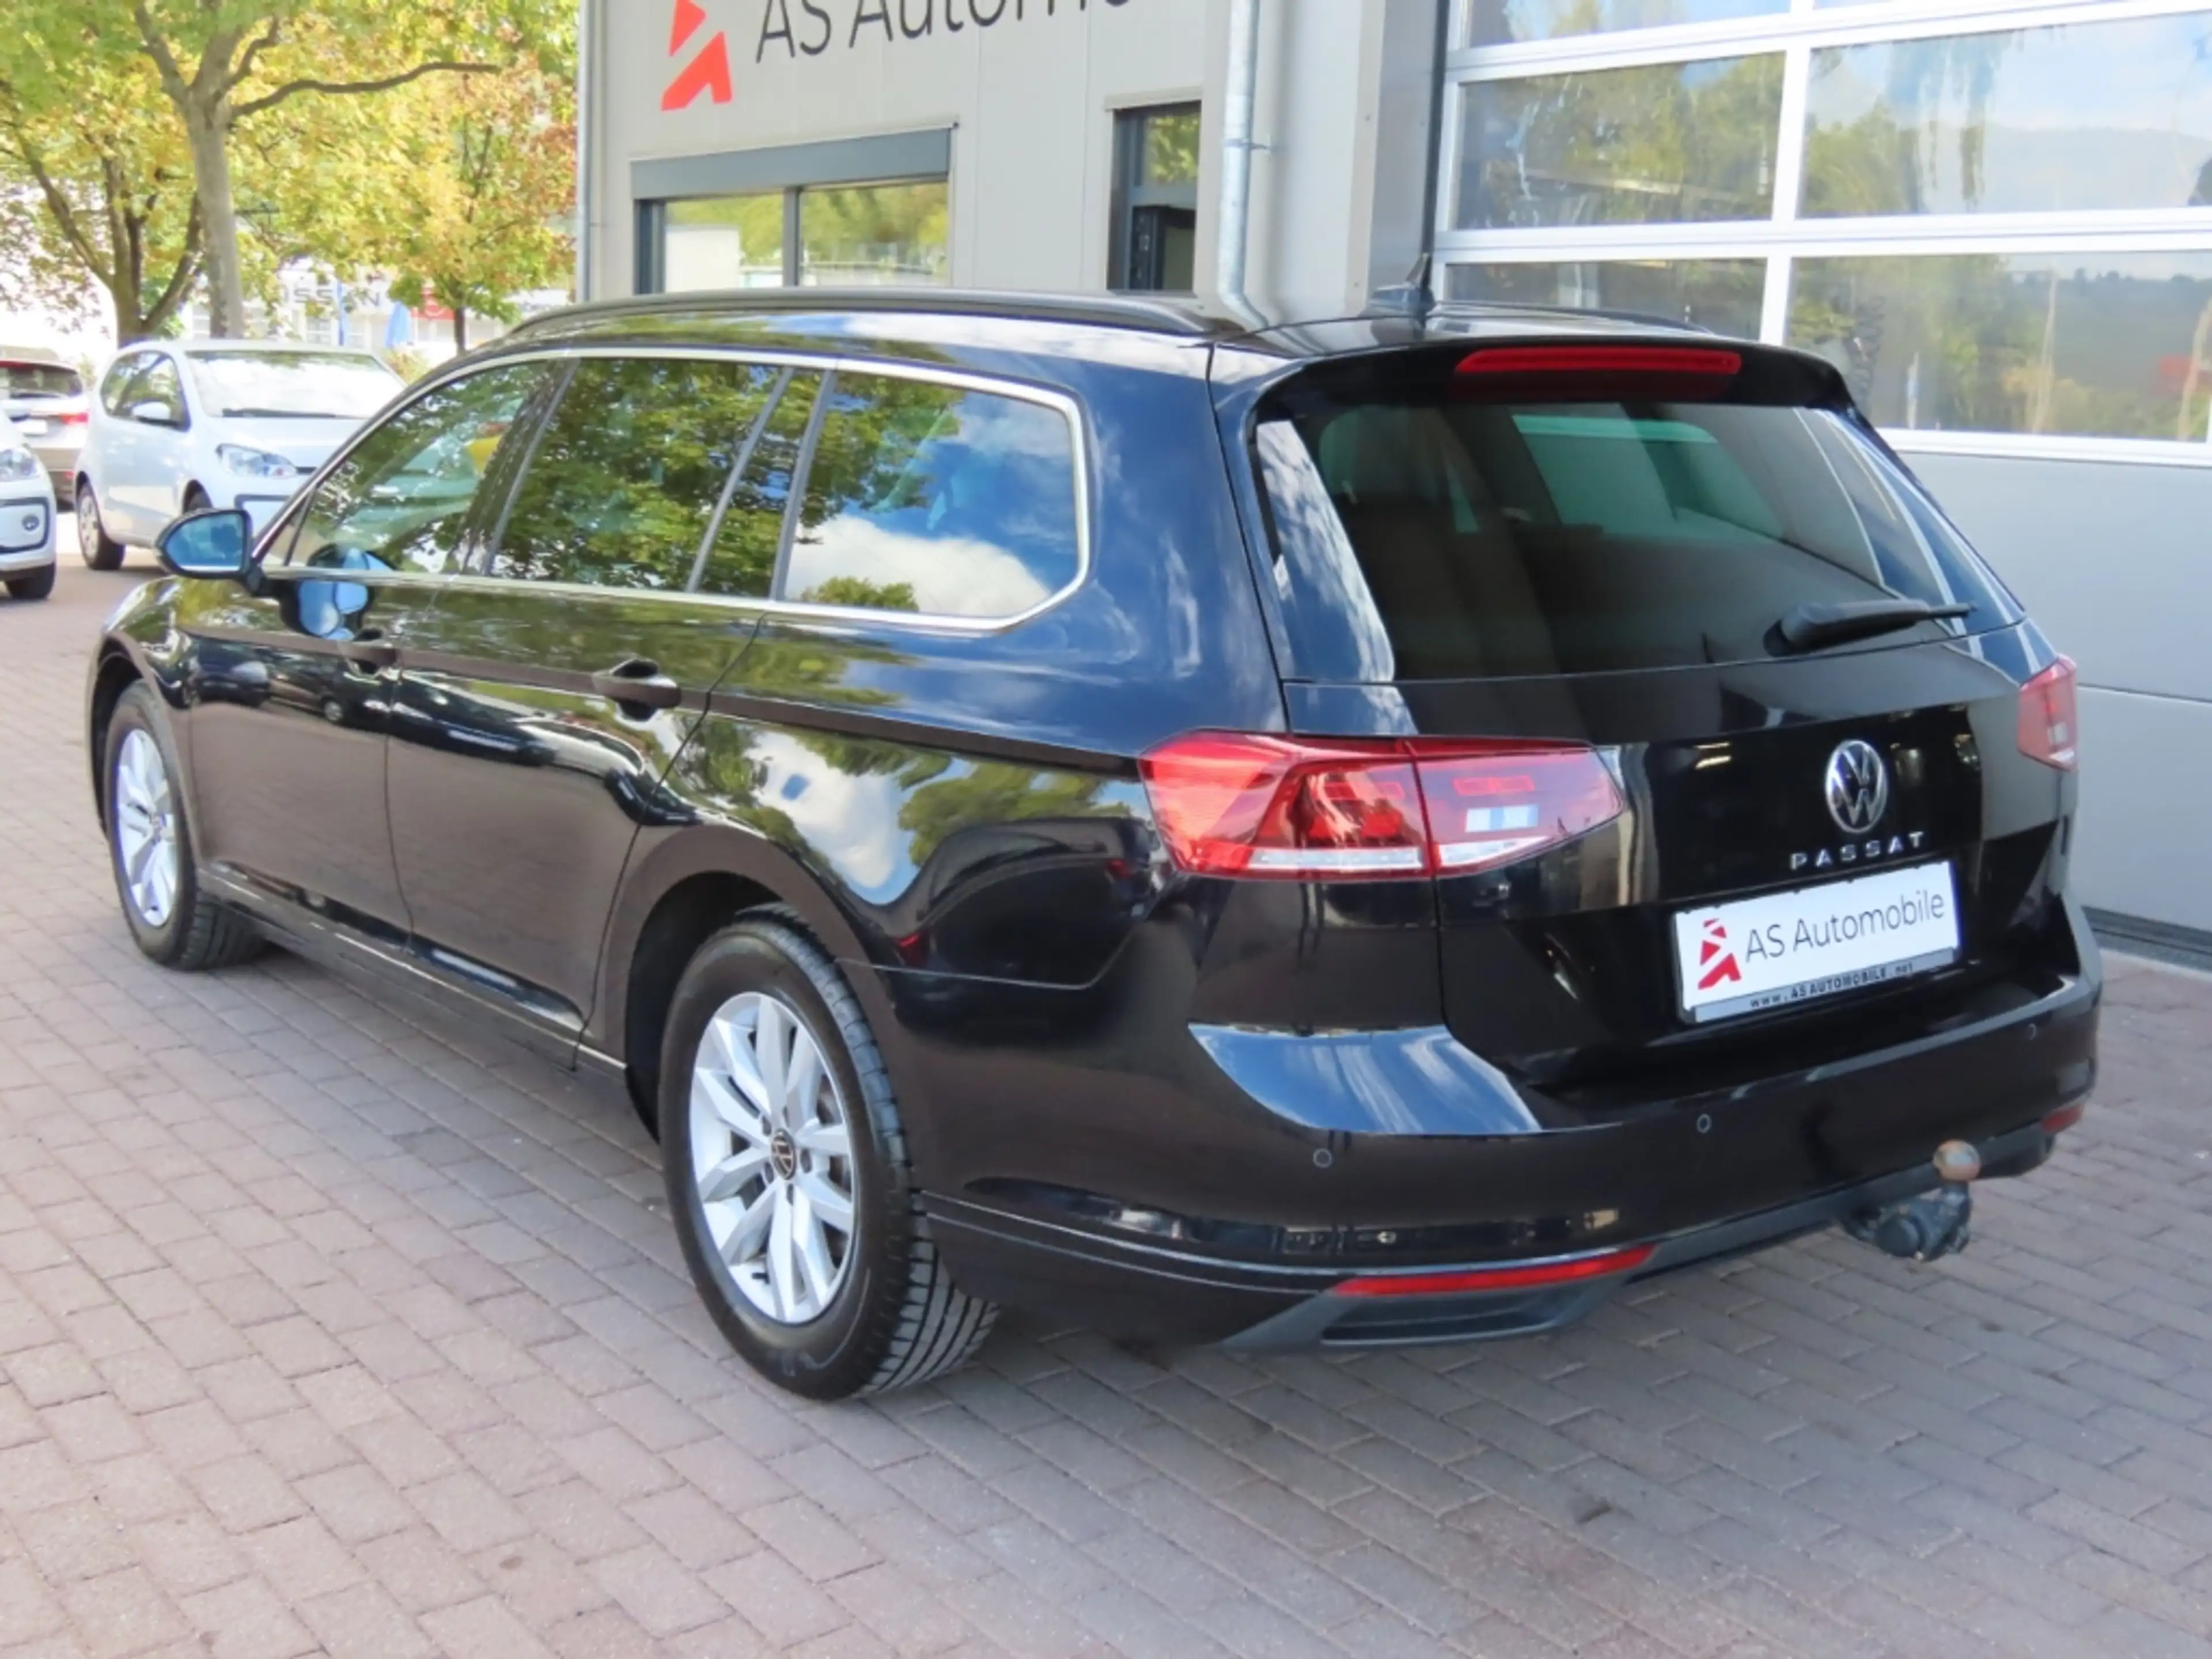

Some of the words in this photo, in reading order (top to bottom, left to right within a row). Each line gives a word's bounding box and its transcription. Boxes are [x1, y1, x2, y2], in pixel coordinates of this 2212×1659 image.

[755, 0, 831, 64] AS
[1790, 831, 1924, 870] PASSAT
[1745, 924, 1785, 963] AS
[1793, 889, 1944, 952] Automobile
